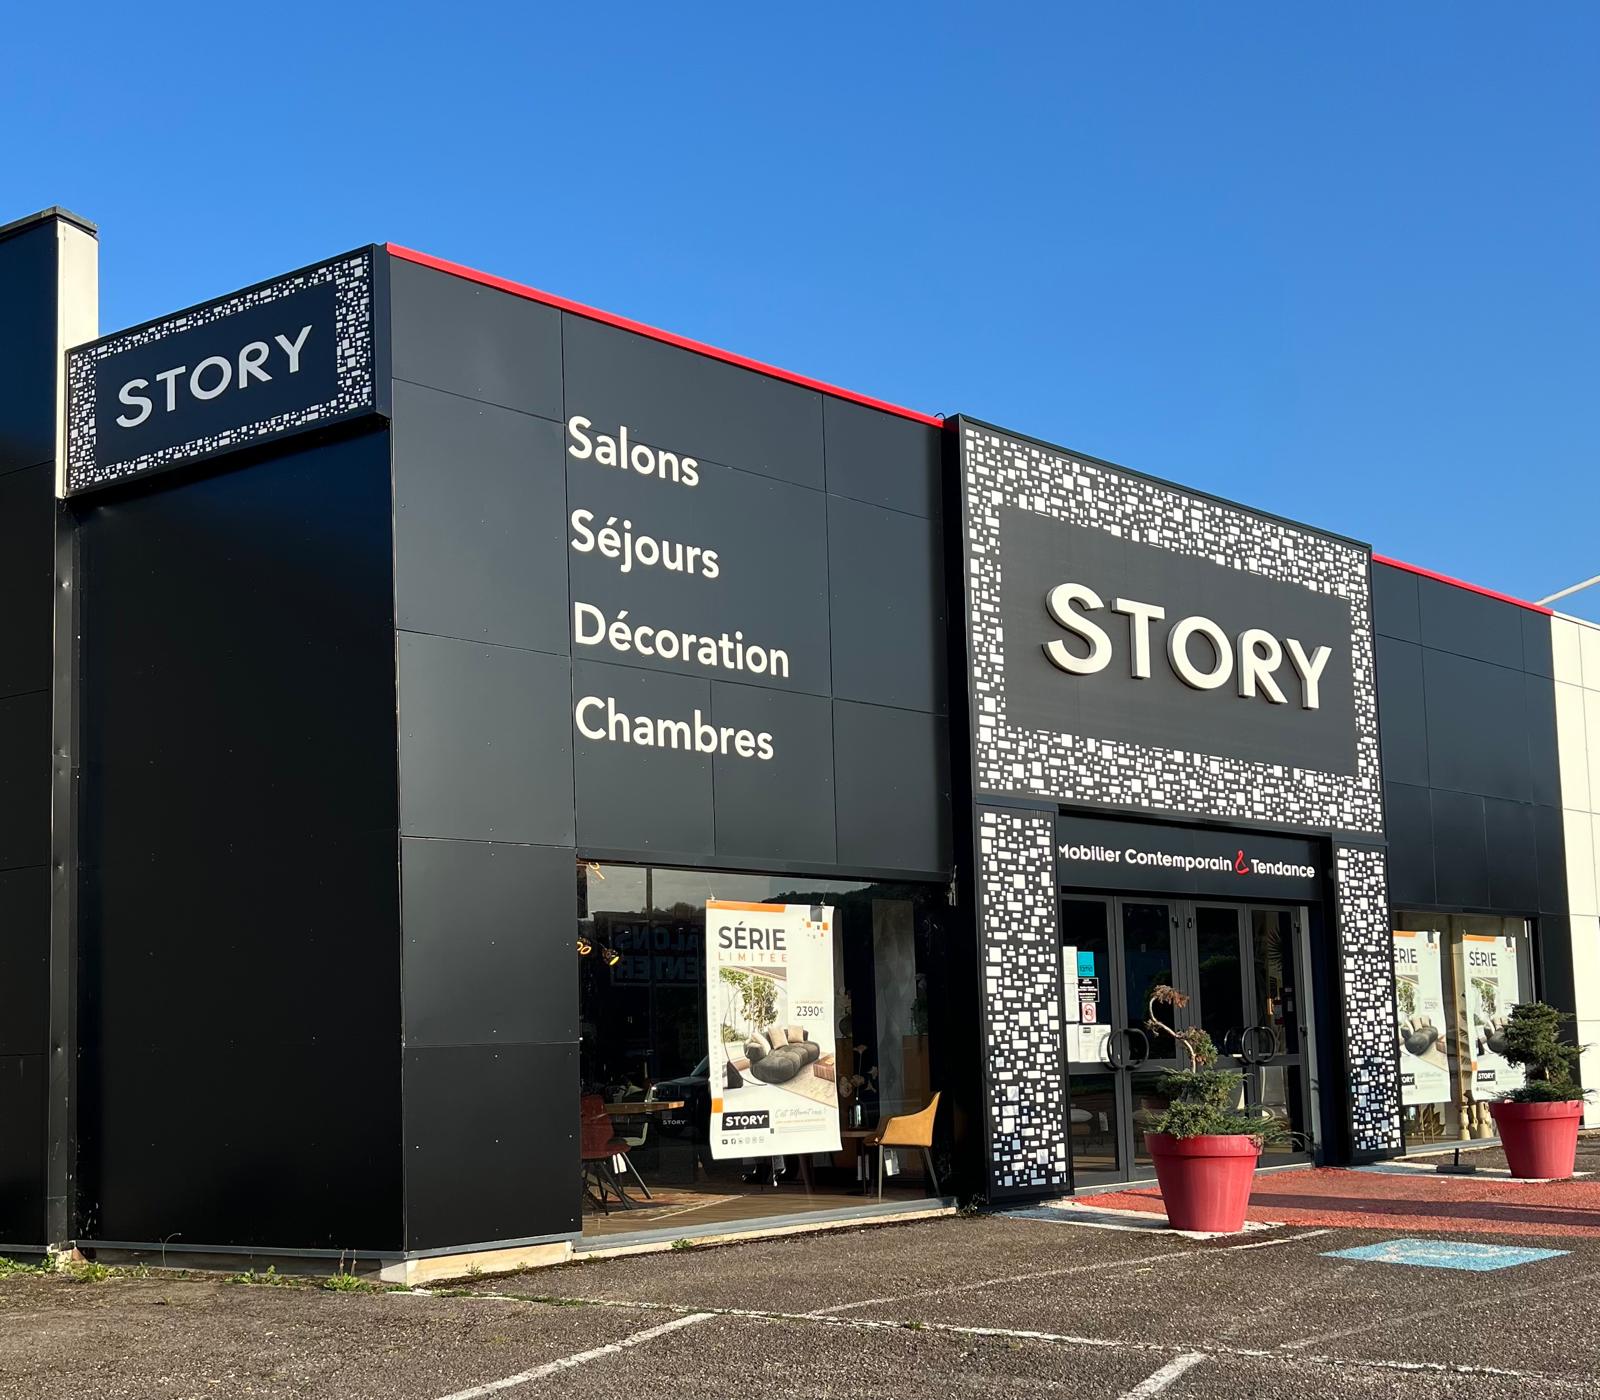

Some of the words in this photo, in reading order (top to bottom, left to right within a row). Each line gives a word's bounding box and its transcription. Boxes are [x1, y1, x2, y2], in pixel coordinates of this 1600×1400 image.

[115, 325, 313, 428] STORY
[568, 415, 699, 486] Salons
[570, 508, 720, 579] Séjours
[574, 601, 789, 678] Décoration
[1042, 582, 1332, 710] STORY
[575, 696, 774, 760] Chambres
[1058, 844, 1121, 863] Mobilier
[1125, 848, 1232, 872] Contemporain
[1234, 850, 1250, 875] &
[1250, 859, 1315, 878] Tendance
[718, 921, 787, 951] SÉRIE
[1469, 947, 1498, 967] SÉRIE
[1477, 1072, 1495, 1080] STORY
[725, 1114, 765, 1127] STORY
